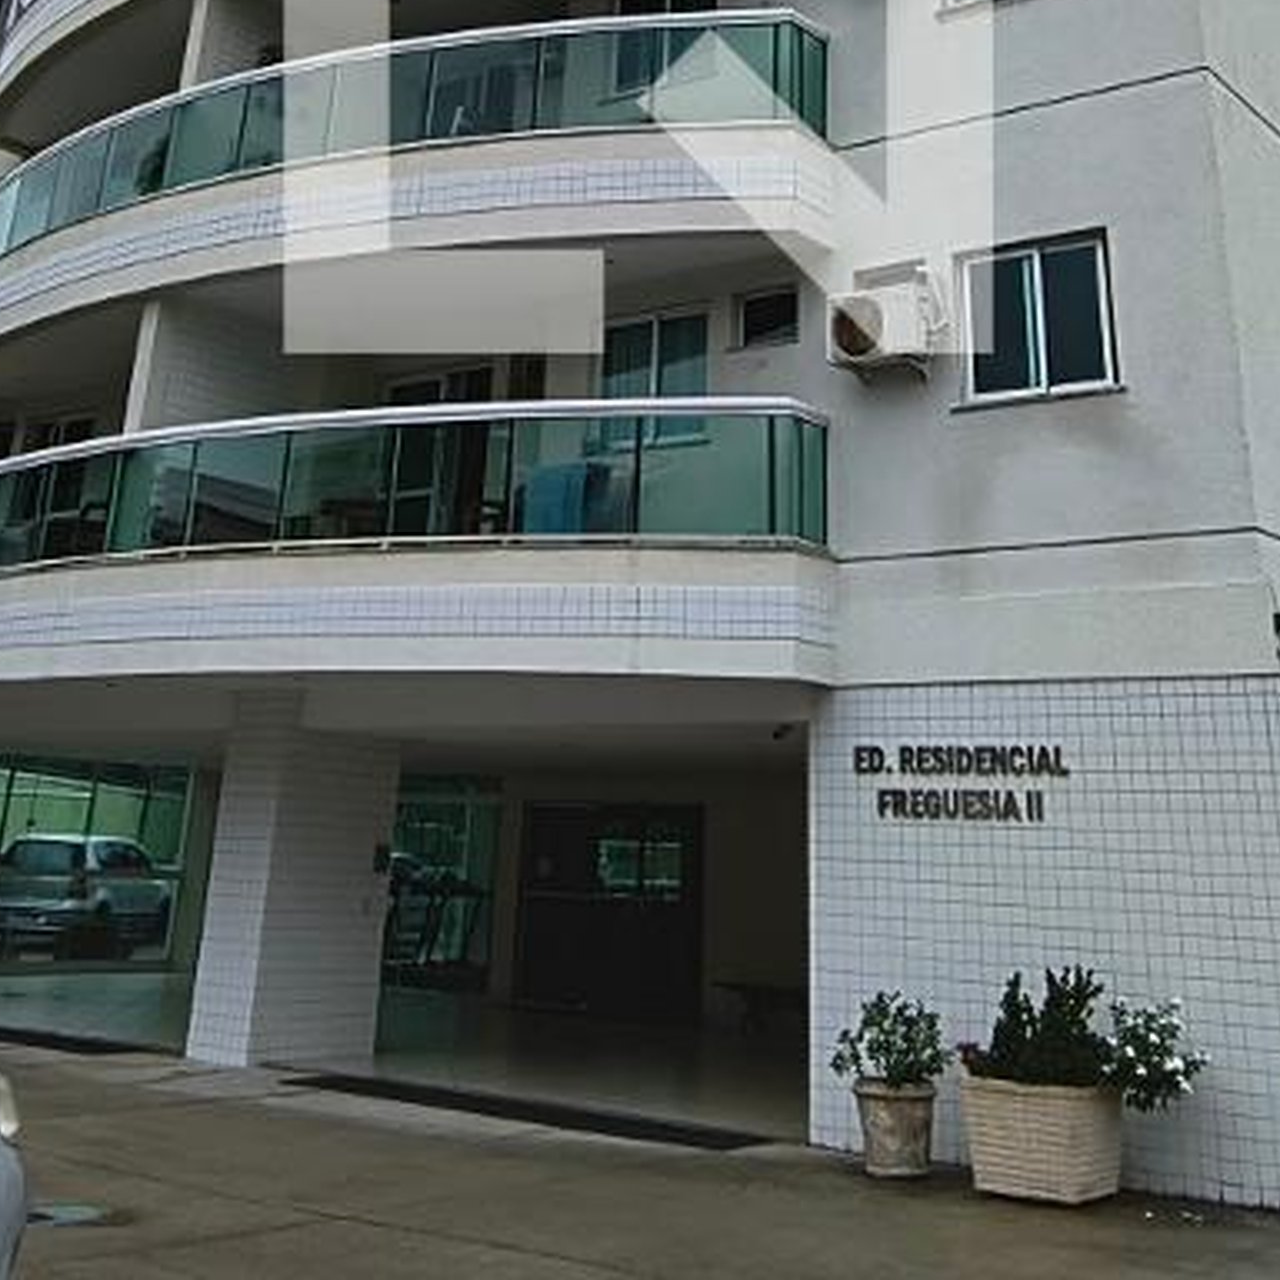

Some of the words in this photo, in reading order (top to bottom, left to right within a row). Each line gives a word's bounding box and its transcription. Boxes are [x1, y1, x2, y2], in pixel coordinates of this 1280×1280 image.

[854, 746, 893, 775] ED.
[899, 745, 1070, 777] RESIDENCIAL
[878, 788, 1022, 821] FREGUESIA
[1027, 790, 1044, 822] II
